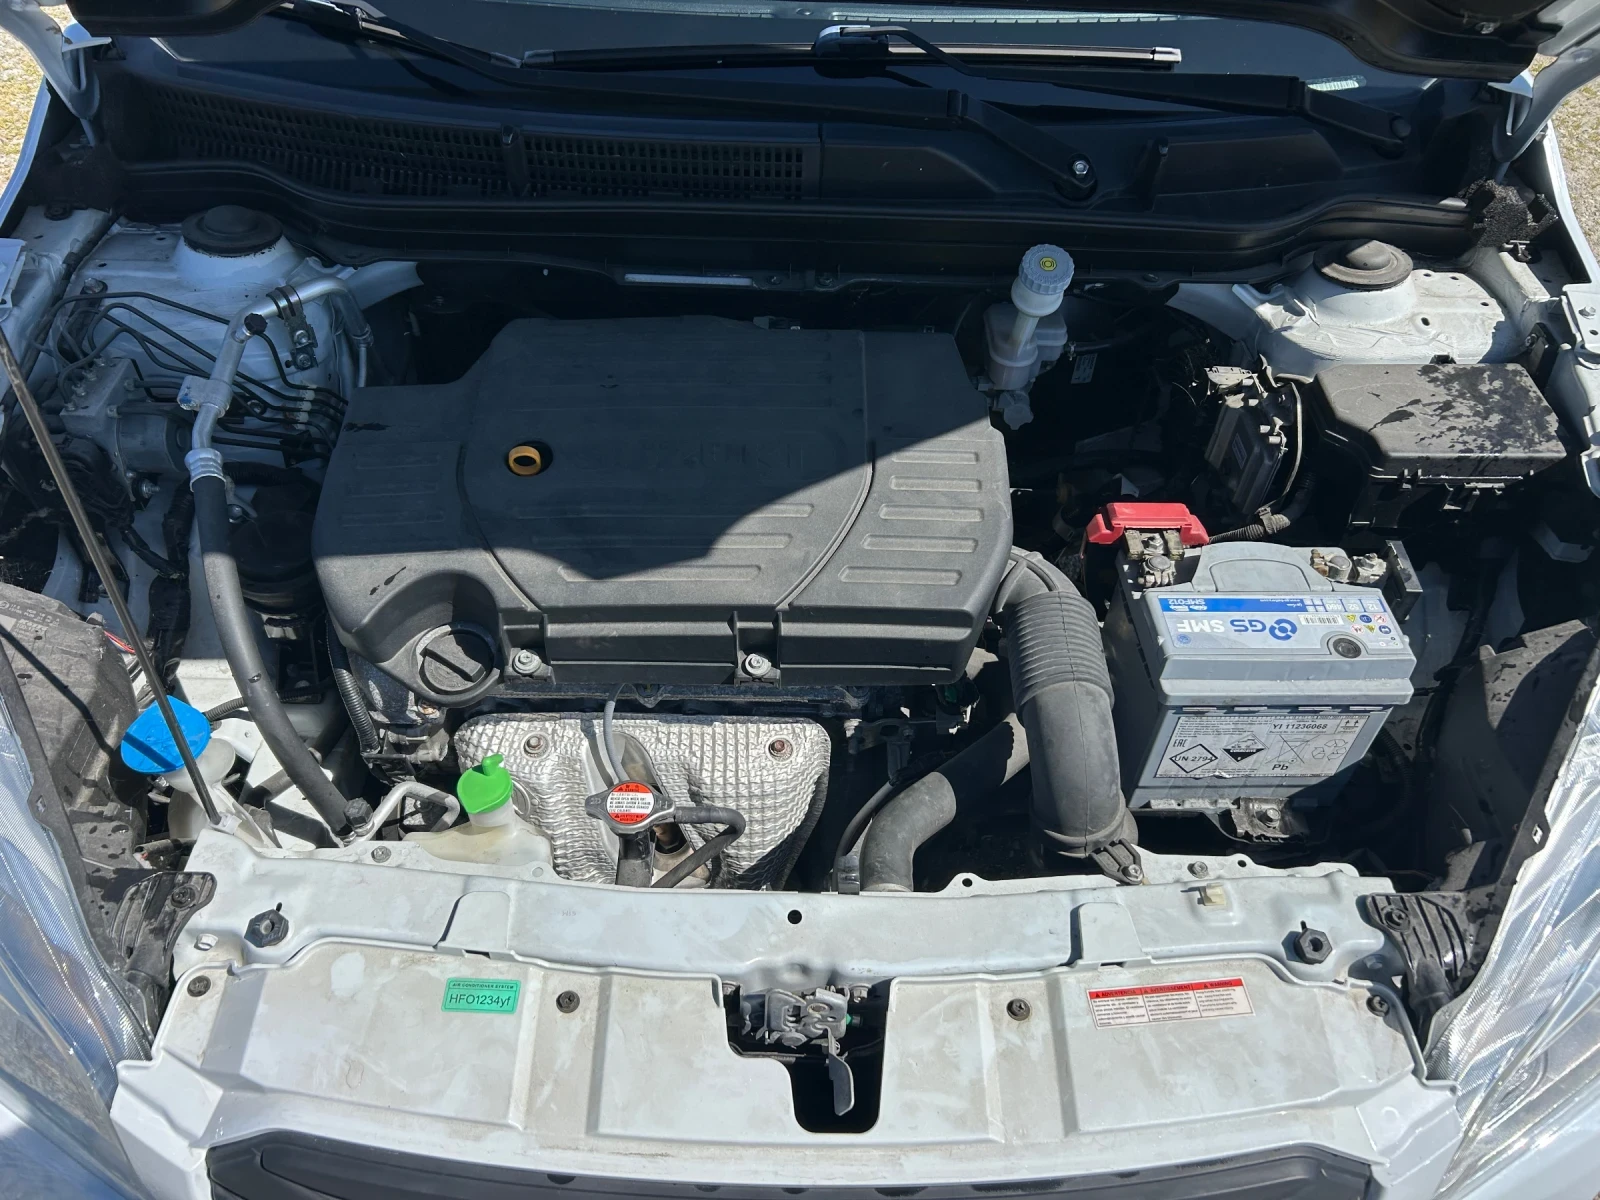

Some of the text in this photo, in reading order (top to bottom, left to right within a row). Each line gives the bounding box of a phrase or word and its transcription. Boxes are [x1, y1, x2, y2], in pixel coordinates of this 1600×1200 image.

[1176, 619, 1267, 633] GS SMF
[1271, 763, 1289, 771] Pb
[449, 993, 511, 1008] HFO1234yf
